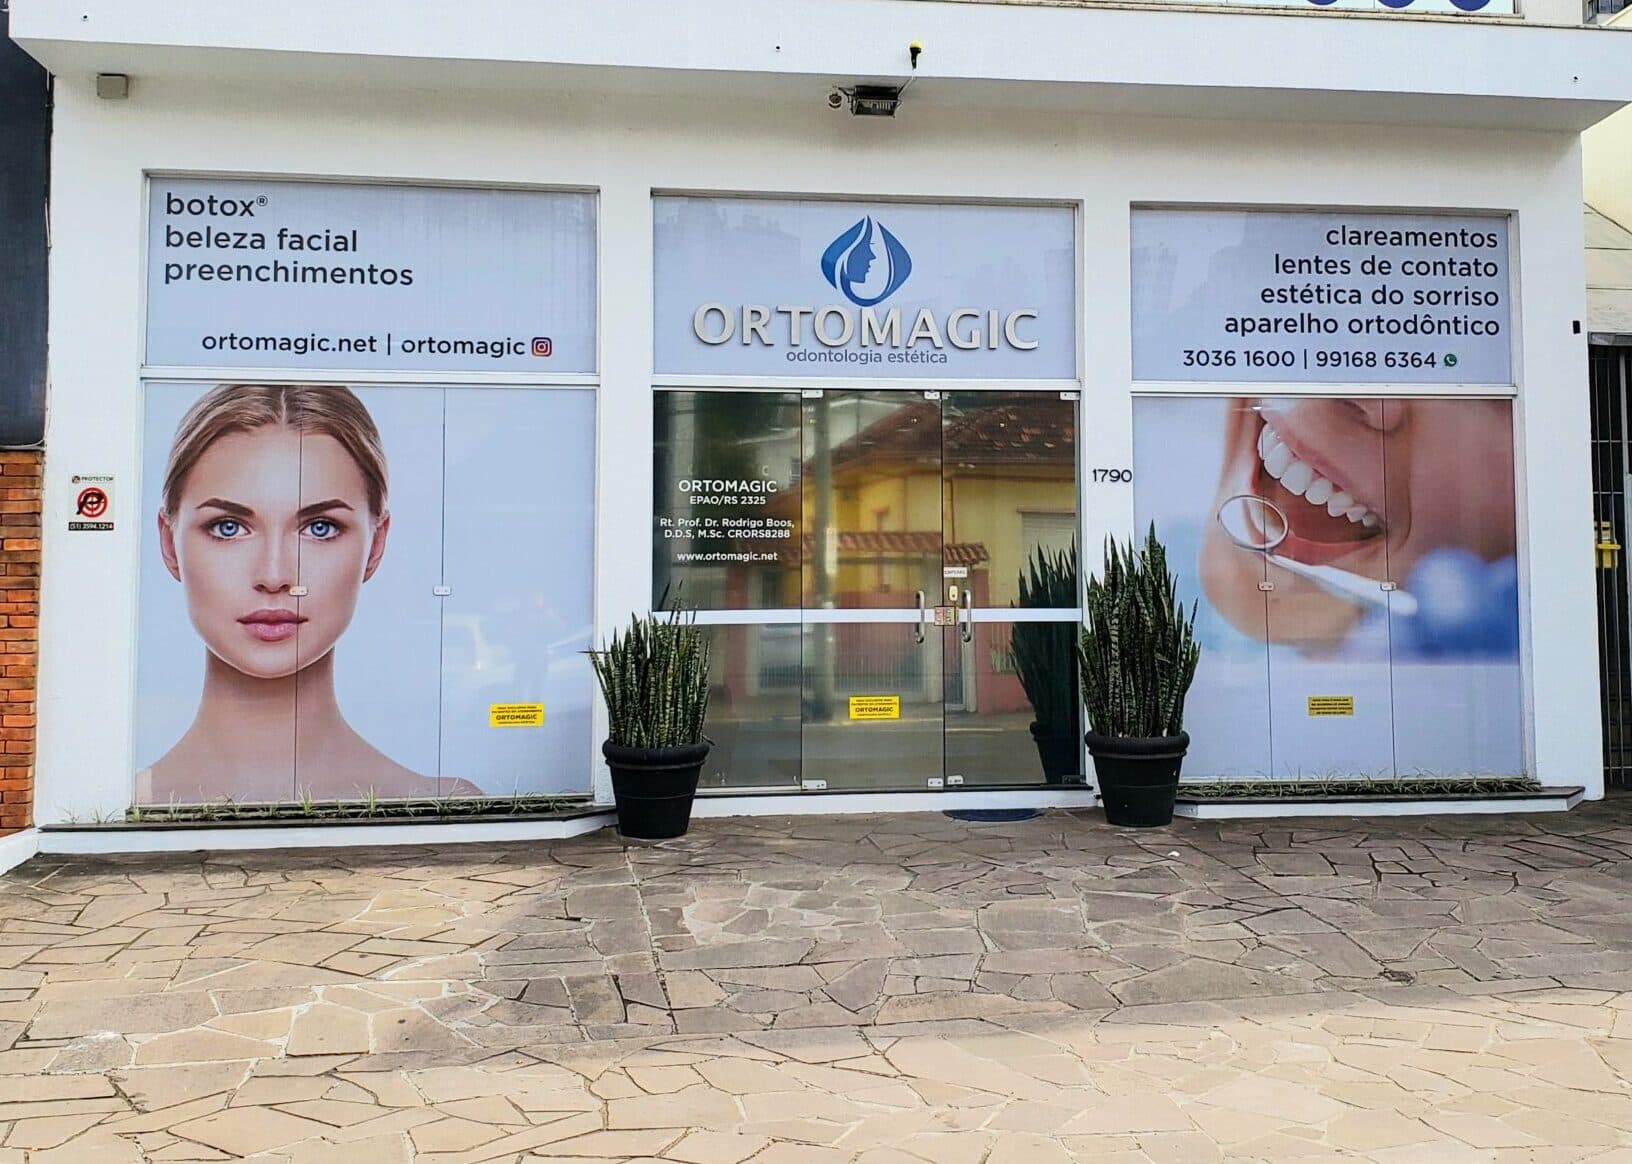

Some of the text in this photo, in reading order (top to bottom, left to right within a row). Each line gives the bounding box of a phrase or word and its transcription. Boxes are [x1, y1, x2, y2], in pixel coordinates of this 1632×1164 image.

[166, 225, 356, 251] beleza facial
[1327, 225, 1497, 248] clareamentos
[165, 260, 412, 285] preenchimentos
[1276, 254, 1498, 277] lentes de contato
[1261, 283, 1498, 306] estética do sorriso
[694, 303, 1040, 350] ORTOMAGIC
[1225, 313, 1499, 337] aparelho ortodôntico
[202, 333, 377, 354] ortomagic.net
[402, 337, 525, 358] ortomagic
[787, 349, 948, 364] odontologia estética
[1184, 350, 1236, 366] 3036
[1244, 351, 1295, 366] 1600
[1317, 351, 1376, 367] 99168
[1385, 352, 1436, 368] 6364
[1093, 469, 1132, 482] 1790
[679, 480, 777, 492] ORTOMAGIC
[690, 495, 766, 505] EPAO/RS 2325
[660, 518, 794, 529] Rt. Prof. Dr. Rodrigo Boos,
[664, 529, 790, 539] D.D.S, M.Sc. CRORS8288
[677, 551, 778, 561] www.ortomagic.net
